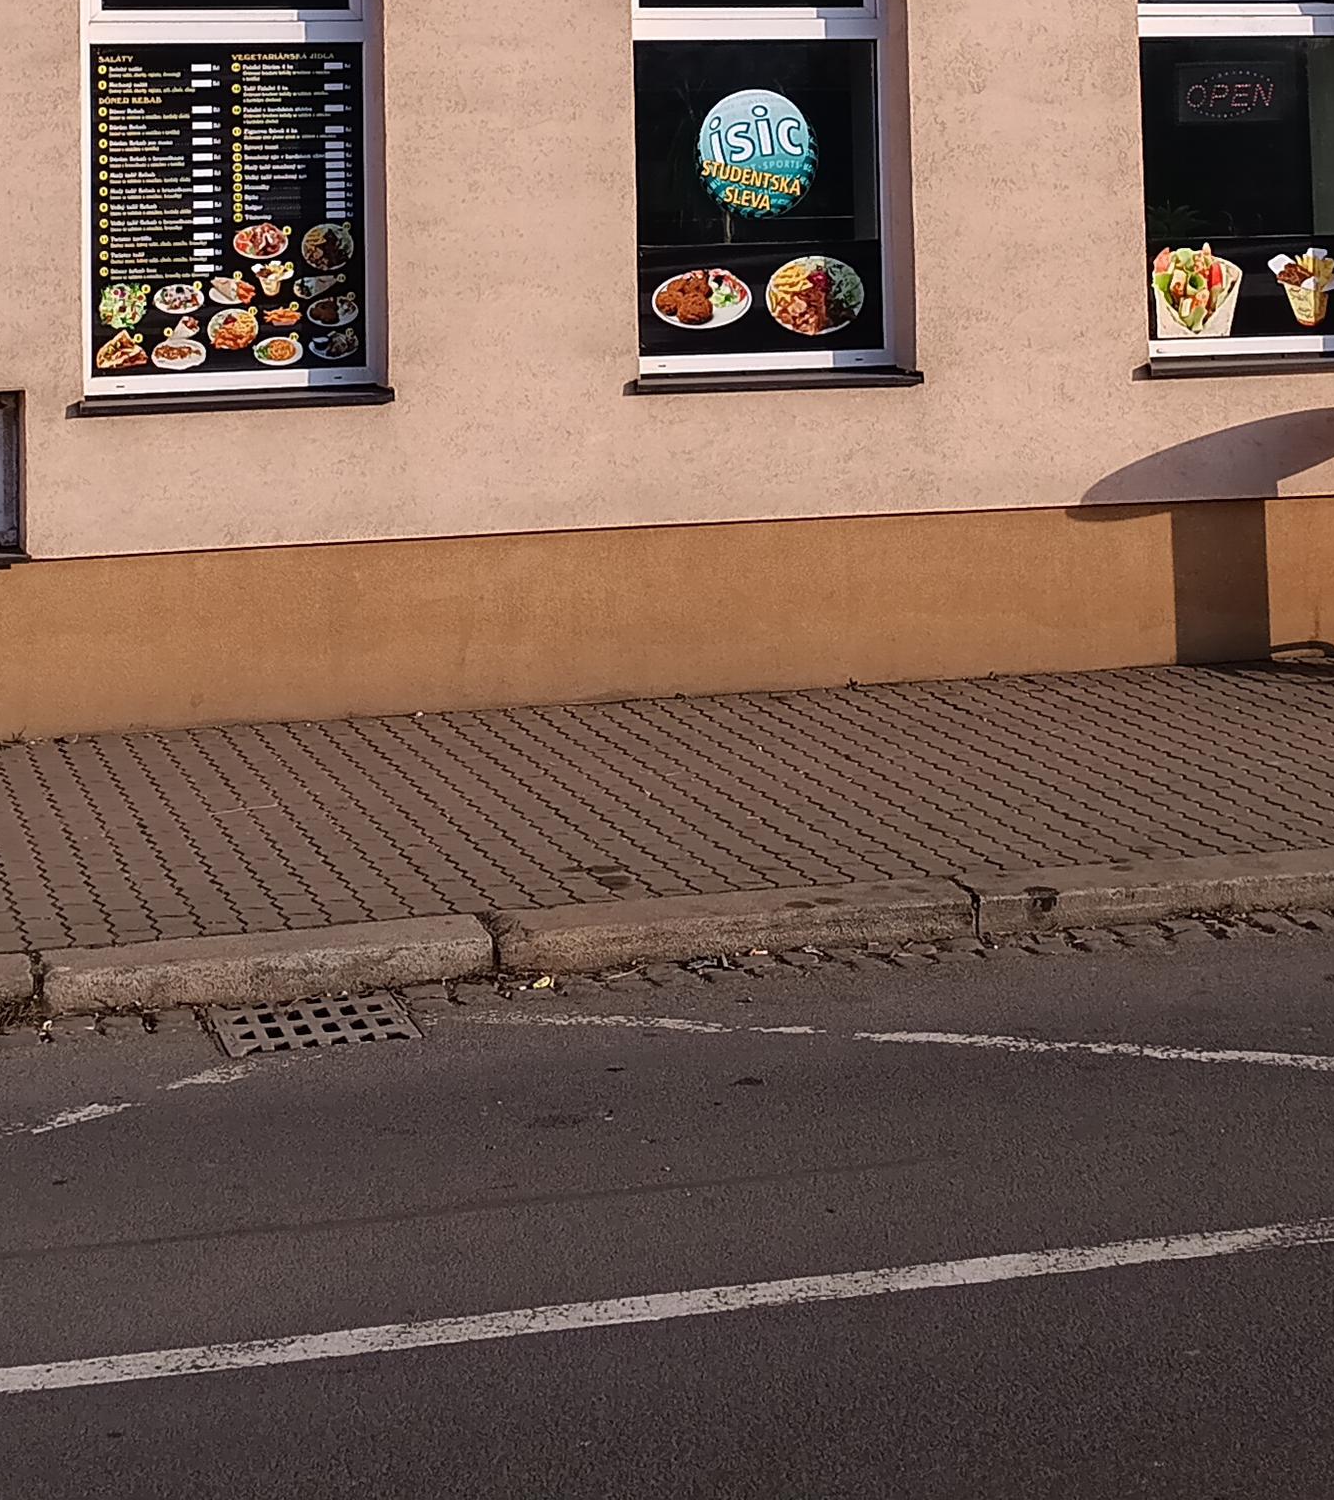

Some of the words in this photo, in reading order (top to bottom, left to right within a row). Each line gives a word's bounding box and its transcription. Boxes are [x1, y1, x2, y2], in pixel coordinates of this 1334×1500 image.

[1185, 82, 1275, 109] OPEN
[709, 105, 805, 165] isic
[701, 160, 802, 196] STUDENTSKÁ
[723, 186, 772, 211] SLEVA
